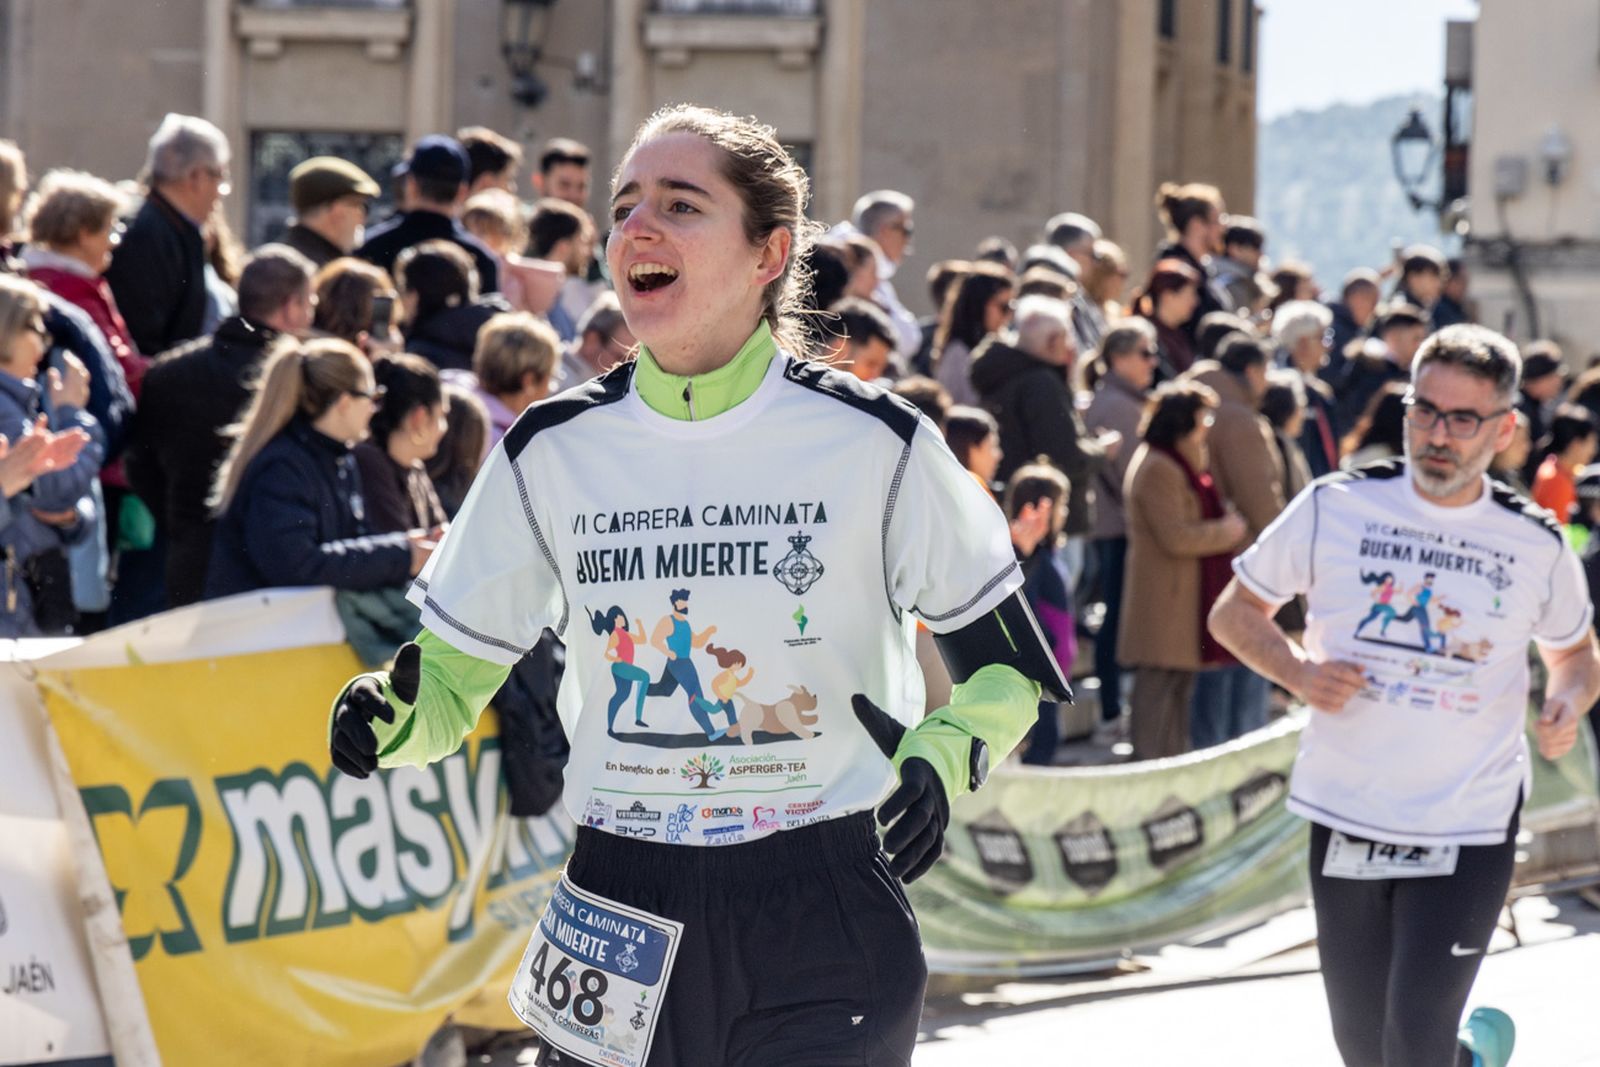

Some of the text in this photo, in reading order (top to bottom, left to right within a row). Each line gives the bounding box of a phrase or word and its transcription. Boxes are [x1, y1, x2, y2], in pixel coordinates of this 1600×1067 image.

[570, 501, 828, 535] VI CARRERA CAMINATA
[577, 541, 769, 584] BUENA MUERTE
[1359, 538, 1484, 576] BUENA MUERTE
[605, 761, 617, 771] En
[619, 763, 654, 776] beneficio
[656, 767, 670, 775] de
[728, 752, 776, 764] Asociación
[729, 762, 806, 776] ASPERGER-TEA
[785, 773, 807, 784] Jaén
[555, 918, 610, 963] MUERTE
[577, 909, 646, 945] CAMINATA
[3, 954, 56, 995] JAÉN
[529, 940, 609, 1027] 468
[558, 1016, 601, 1040] CONTRERAS
